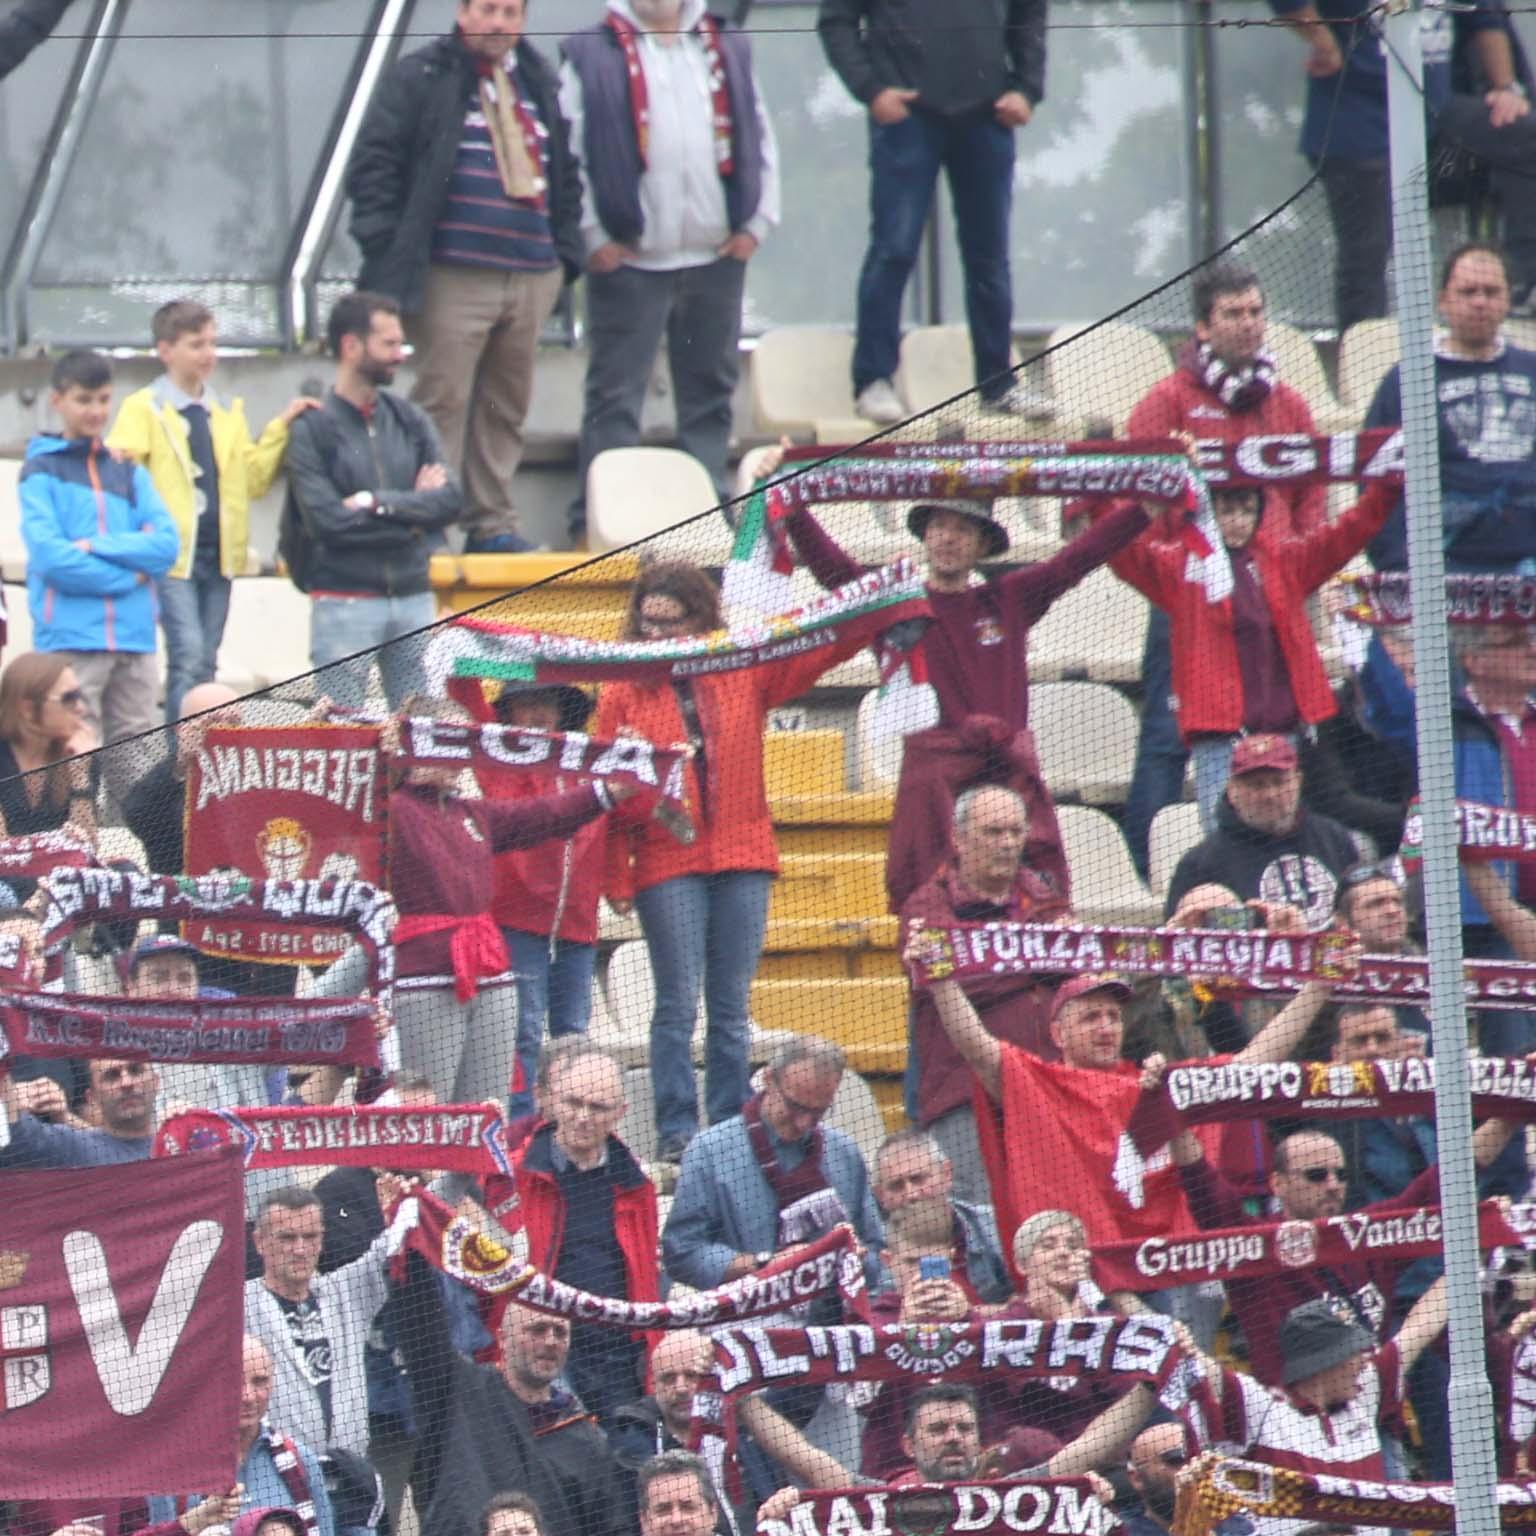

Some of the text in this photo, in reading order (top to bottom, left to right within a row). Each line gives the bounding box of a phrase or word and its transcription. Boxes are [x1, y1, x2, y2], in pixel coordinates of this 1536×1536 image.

[412, 721, 659, 788] EGIA
[1167, 1060, 1303, 1110] GRUPPO
[1135, 1206, 1443, 1278] Gruppo Vande
[61, 1218, 225, 1418] V
[517, 1270, 661, 1330] ANCHE
